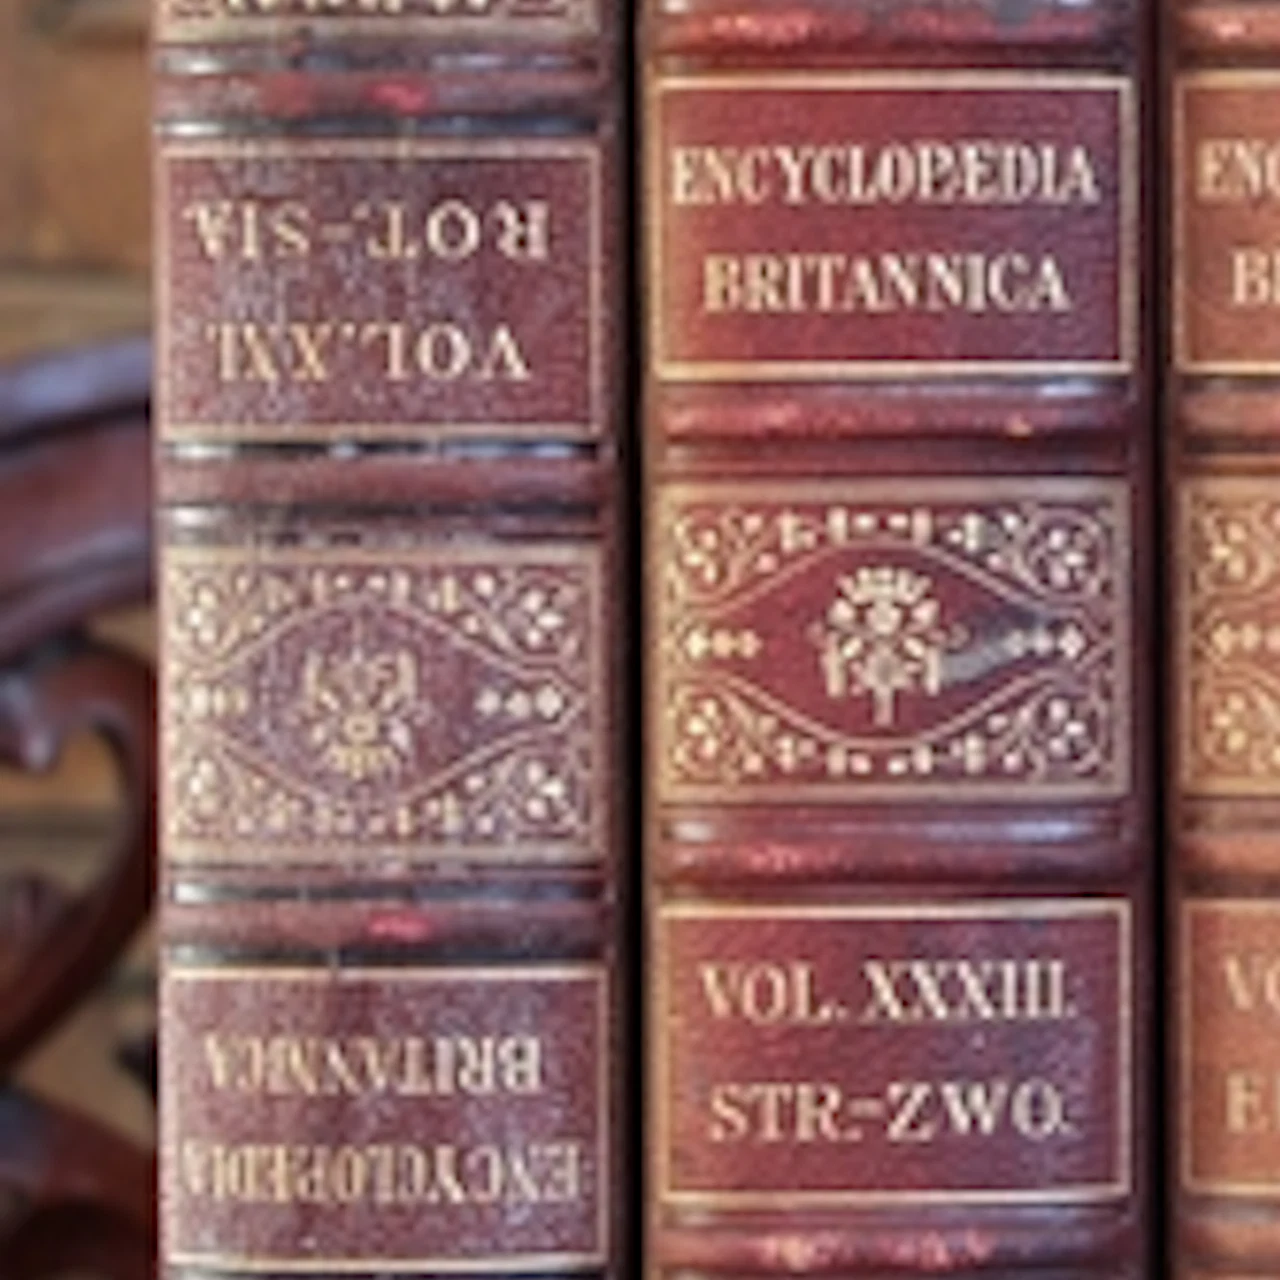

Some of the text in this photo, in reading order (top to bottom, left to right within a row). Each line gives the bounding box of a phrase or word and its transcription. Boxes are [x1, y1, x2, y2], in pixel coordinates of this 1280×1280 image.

[671, 143, 1099, 206] ENCYCLOPÆDIA
[704, 252, 1071, 312] BRITANNICA
[700, 959, 848, 1024] VOL.
[204, 1034, 543, 1096] BRITANNICA
